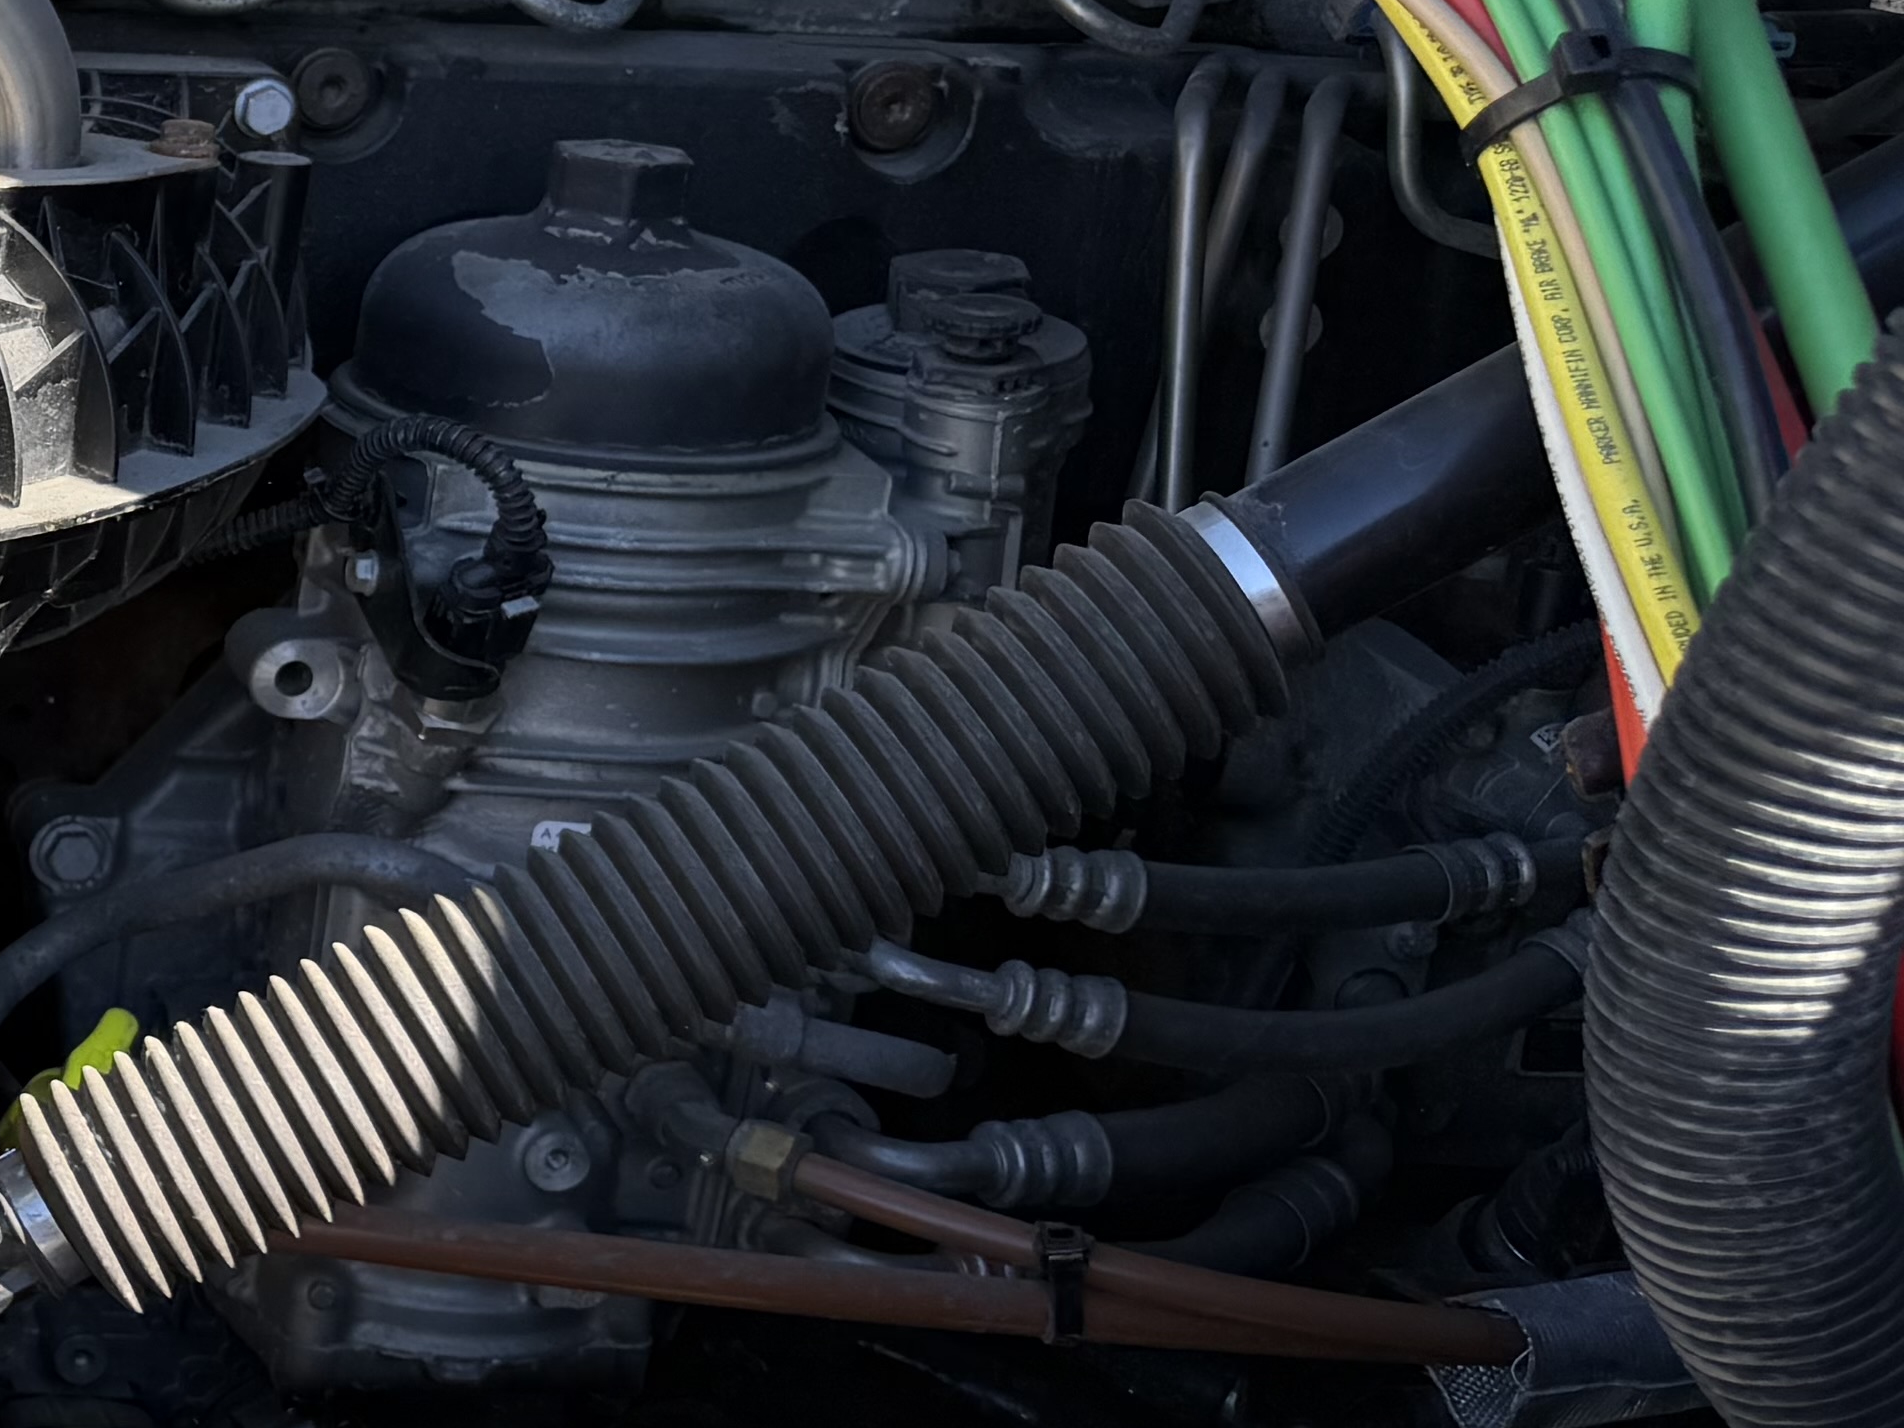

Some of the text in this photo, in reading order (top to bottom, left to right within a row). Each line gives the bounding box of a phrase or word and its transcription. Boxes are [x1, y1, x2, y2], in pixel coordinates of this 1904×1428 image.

[1530, 237, 1621, 465] PARKER HANNIFIN AIR BRAKE
[1655, 584, 1677, 601] IN
